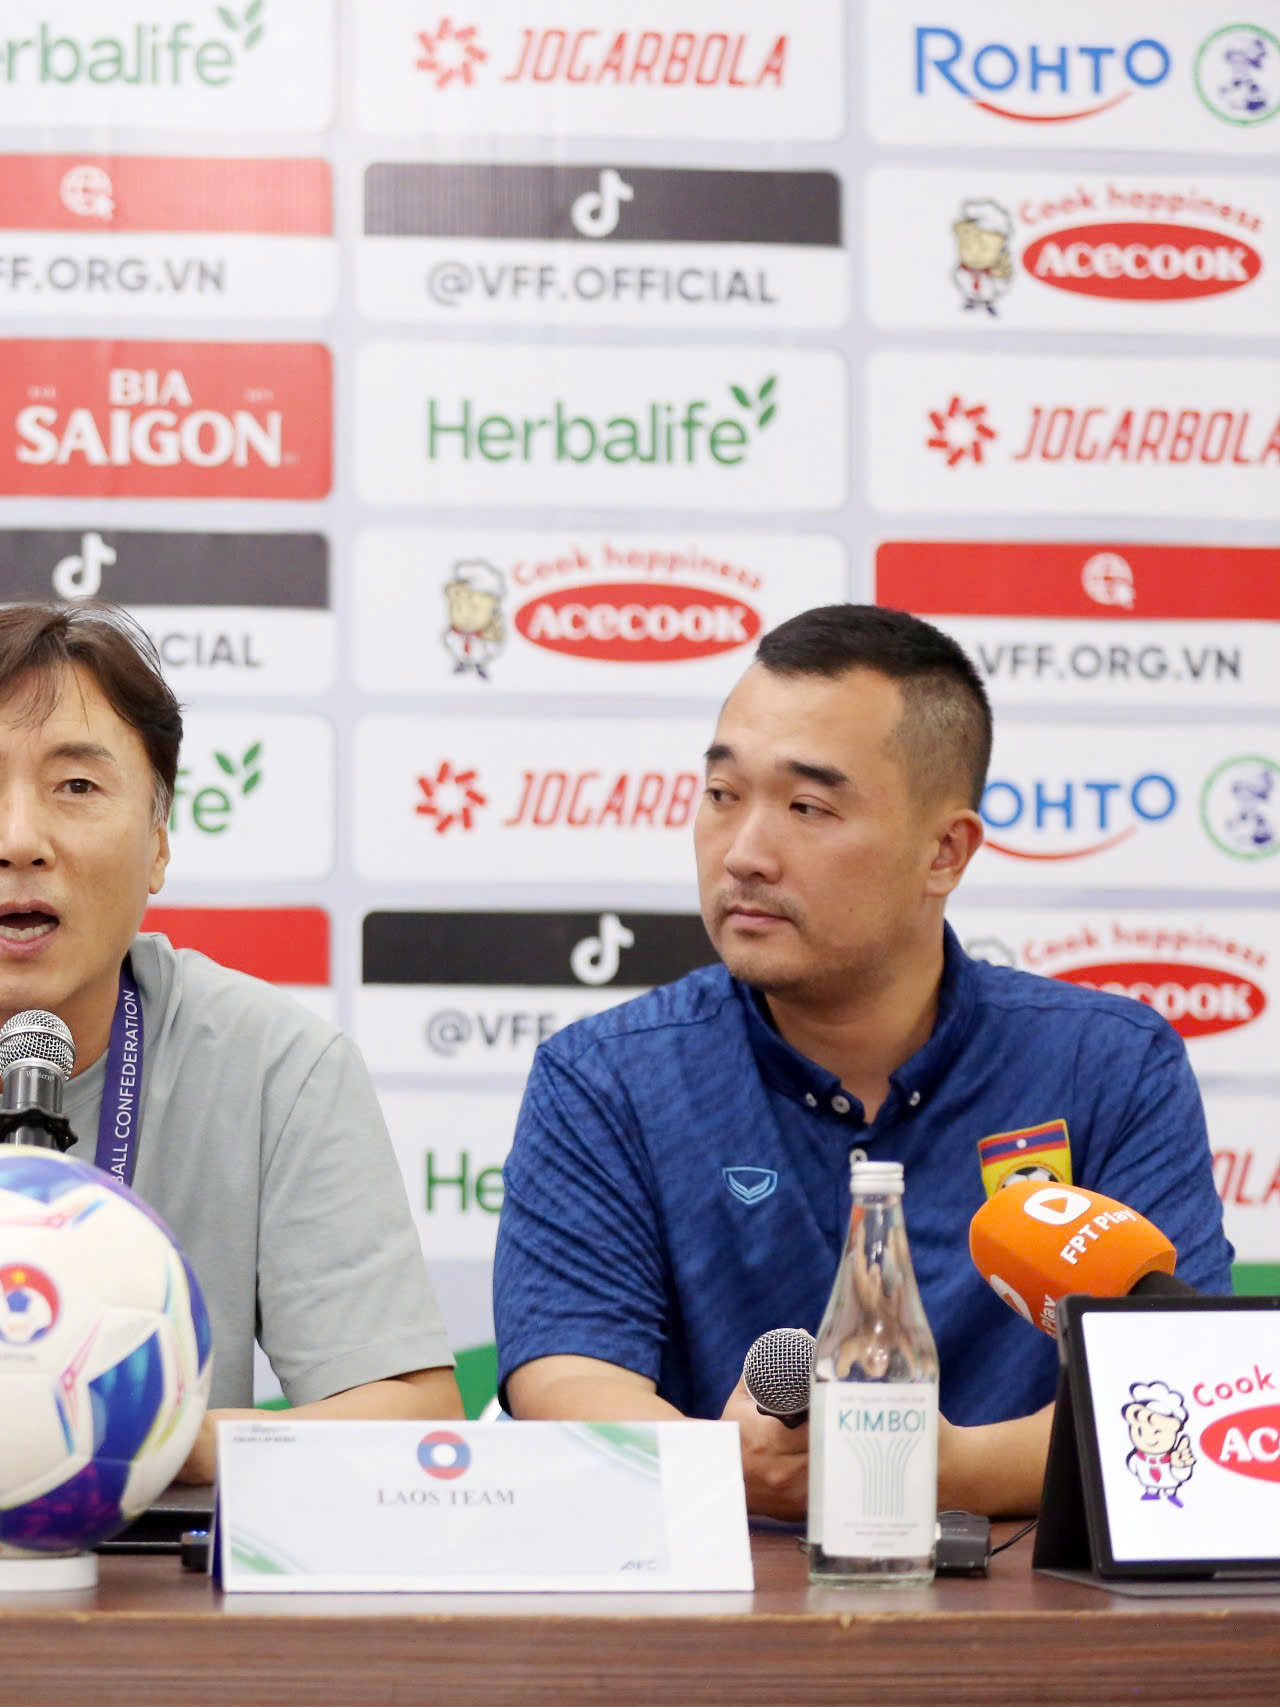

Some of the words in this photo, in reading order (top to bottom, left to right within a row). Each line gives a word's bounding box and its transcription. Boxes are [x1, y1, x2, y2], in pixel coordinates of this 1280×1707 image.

[505, 29, 788, 87] JOGARBOLA
[915, 26, 1172, 96] ROHTO
[1020, 187, 1094, 225] Cook
[1107, 185, 1262, 233] happiness
[430, 263, 776, 305] @VFF.OFFICIAL
[109, 368, 192, 406] BIA
[16, 406, 282, 468] SAIGON
[427, 399, 750, 465] Herbalife
[513, 547, 589, 587] Cook
[604, 544, 762, 591] happiness
[978, 645, 1242, 680] VFF.ORG.VN
[503, 770, 700, 829] JOGARB
[978, 772, 1176, 831] OHTO
[1023, 926, 1099, 964] Cook
[1113, 924, 1267, 969] happiness
[114, 990, 139, 1139] CONFEDERATION
[1060, 1224, 1099, 1264] FPT
[1093, 1209, 1137, 1231] Play
[1192, 1364, 1276, 1407] Cook
[840, 1409, 925, 1432] KIMBOI
[378, 1490, 440, 1504] LAOS
[451, 1490, 514, 1504] TEAM
